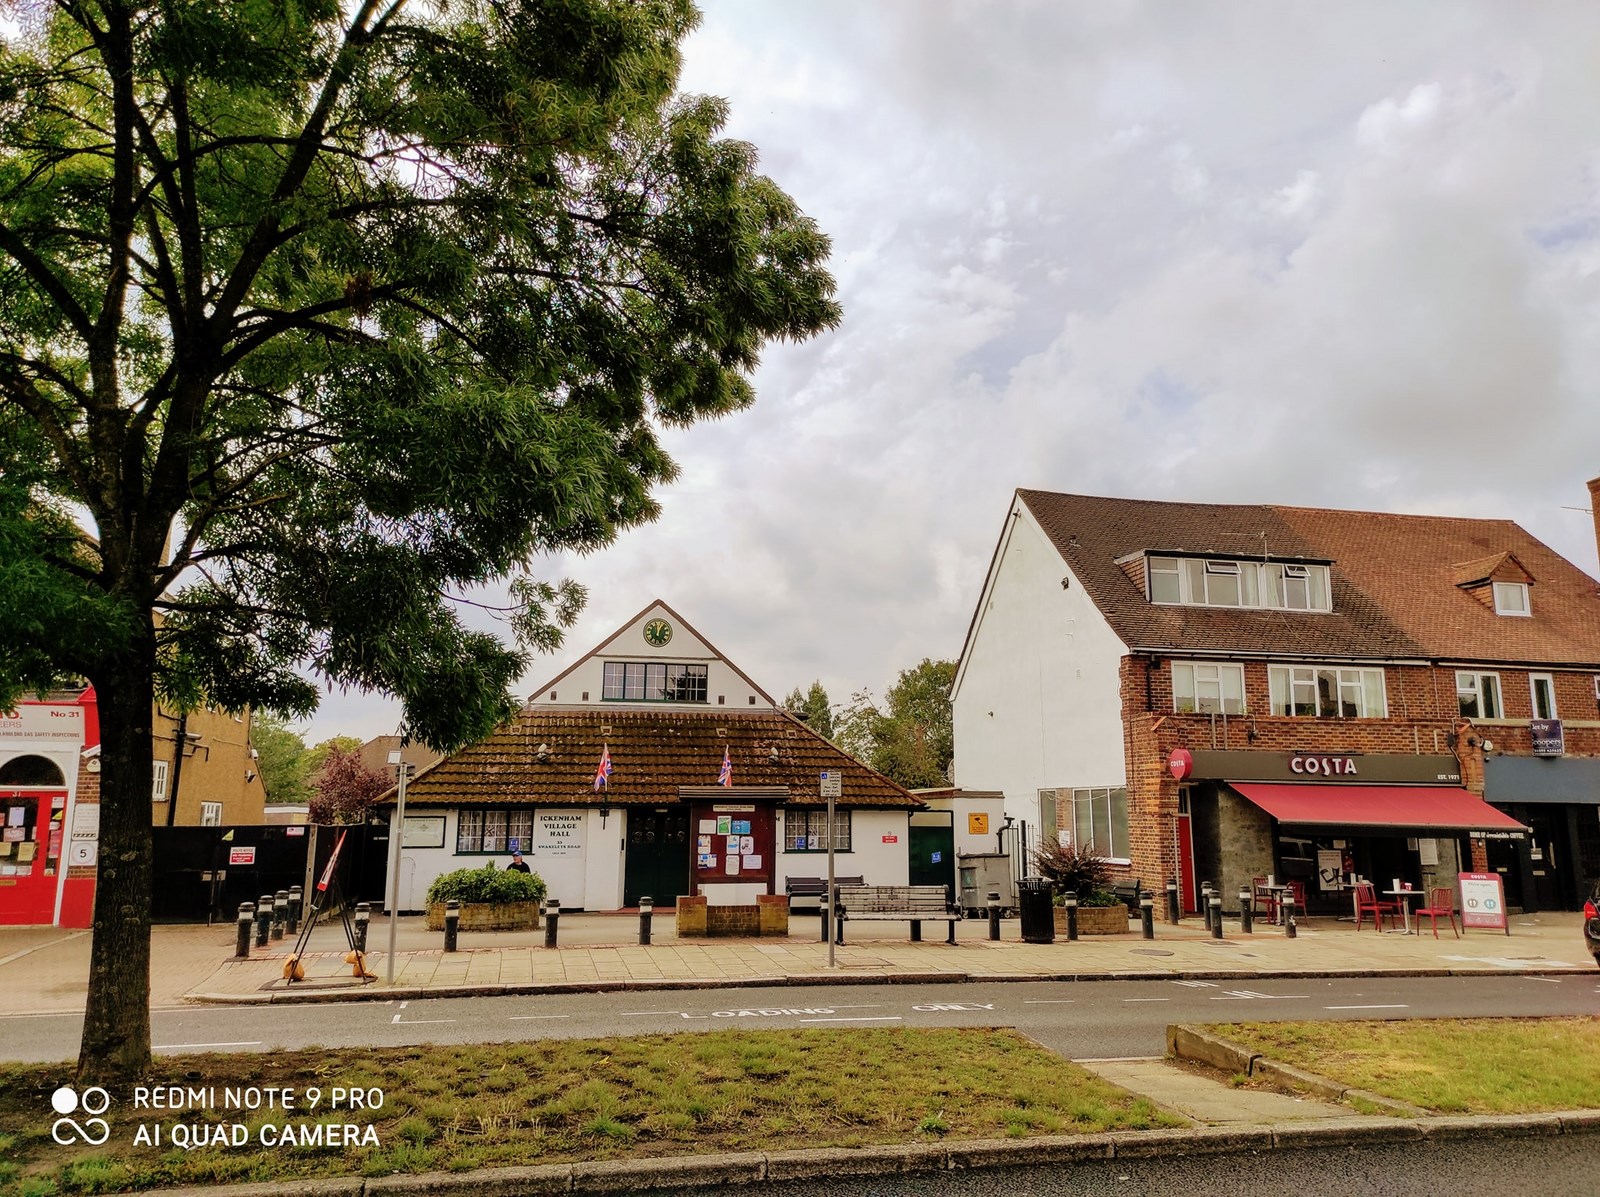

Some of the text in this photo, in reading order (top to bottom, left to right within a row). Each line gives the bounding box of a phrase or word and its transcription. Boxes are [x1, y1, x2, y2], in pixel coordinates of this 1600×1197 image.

[1170, 759, 1184, 767] COSTA
[1291, 757, 1357, 776] COSTA
[80, 848, 87, 858] 5
[681, 1003, 995, 1019] LOADING ONLY
